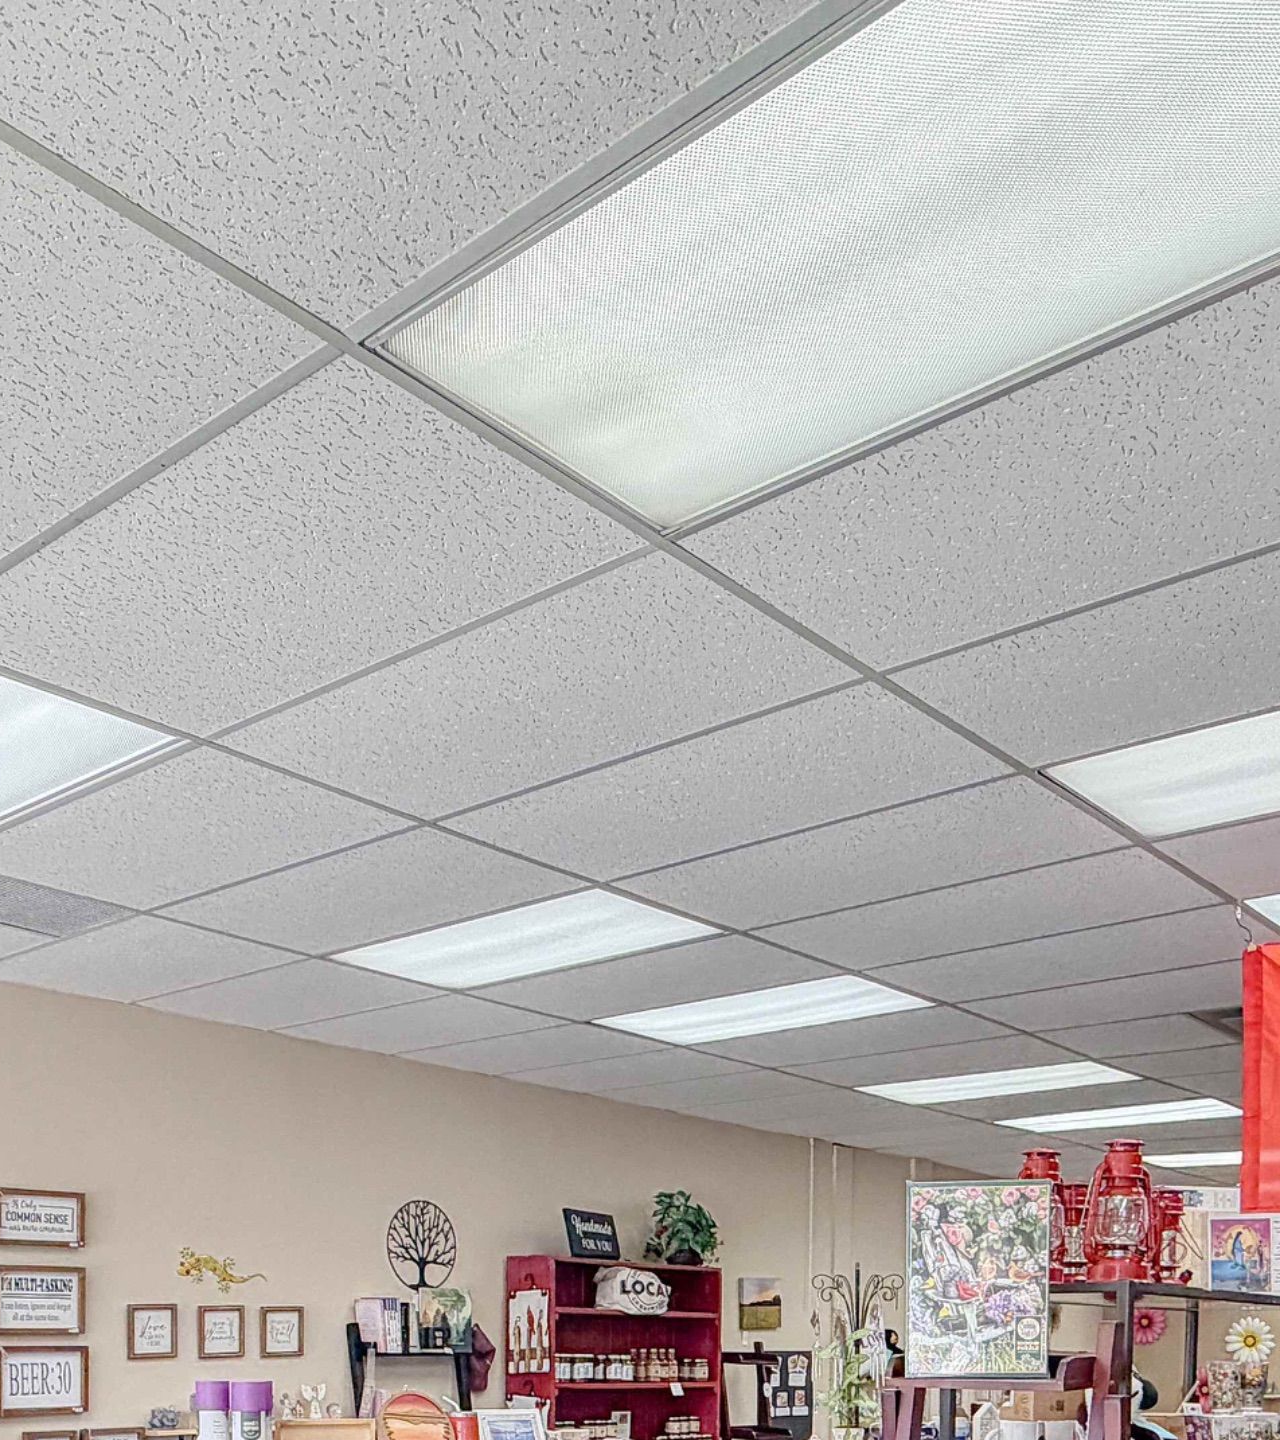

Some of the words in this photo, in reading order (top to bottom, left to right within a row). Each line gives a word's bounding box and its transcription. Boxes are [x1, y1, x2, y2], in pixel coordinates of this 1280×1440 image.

[5, 1210, 42, 1223] COMMON
[43, 1213, 70, 1226] SENSE
[571, 1213, 613, 1237] Handmade
[582, 1237, 597, 1250] FOR
[597, 1239, 613, 1253] YOU
[8, 1361, 72, 1397] BEER:30
